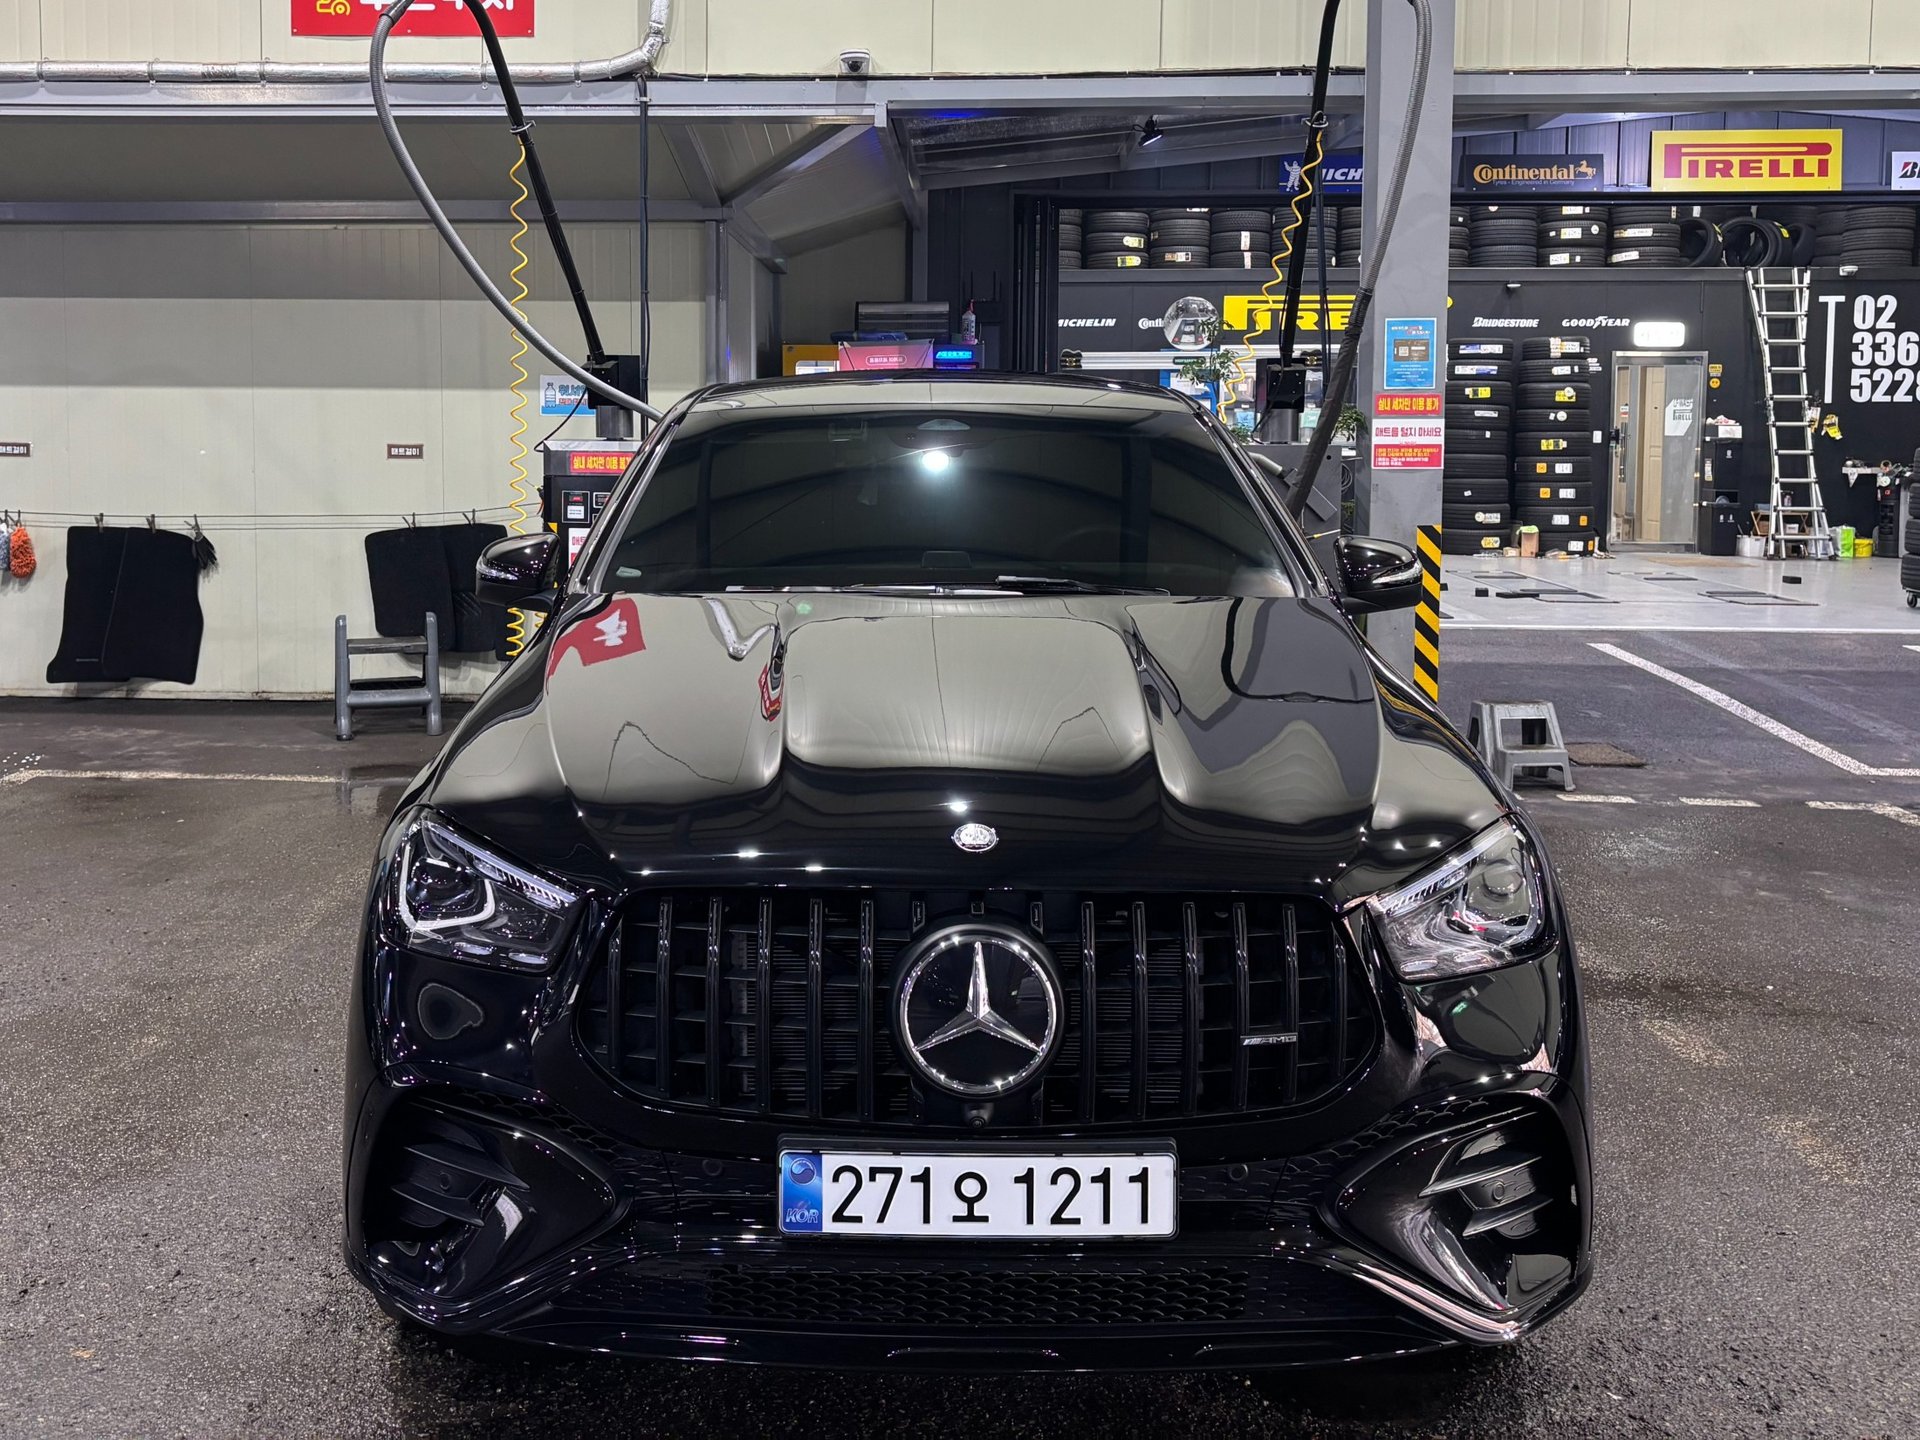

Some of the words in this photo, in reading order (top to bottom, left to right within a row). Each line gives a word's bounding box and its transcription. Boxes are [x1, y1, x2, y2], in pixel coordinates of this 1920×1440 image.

[1664, 142, 1832, 178] PIRELLI
[1899, 162, 1920, 178] B
[1322, 168, 1363, 180] ICH
[1473, 164, 1575, 184] Continental
[1223, 295, 1357, 330] PIRE
[1561, 315, 1630, 329] GOODYEAR
[1853, 294, 1898, 330] 02
[1138, 318, 1164, 330] Conti
[1472, 317, 1540, 328] BRIDGESTONE
[1851, 331, 1920, 366] 336
[1850, 368, 1920, 403] 522
[1013, 1166, 1150, 1225] 1211
[786, 1206, 819, 1224] KOR
